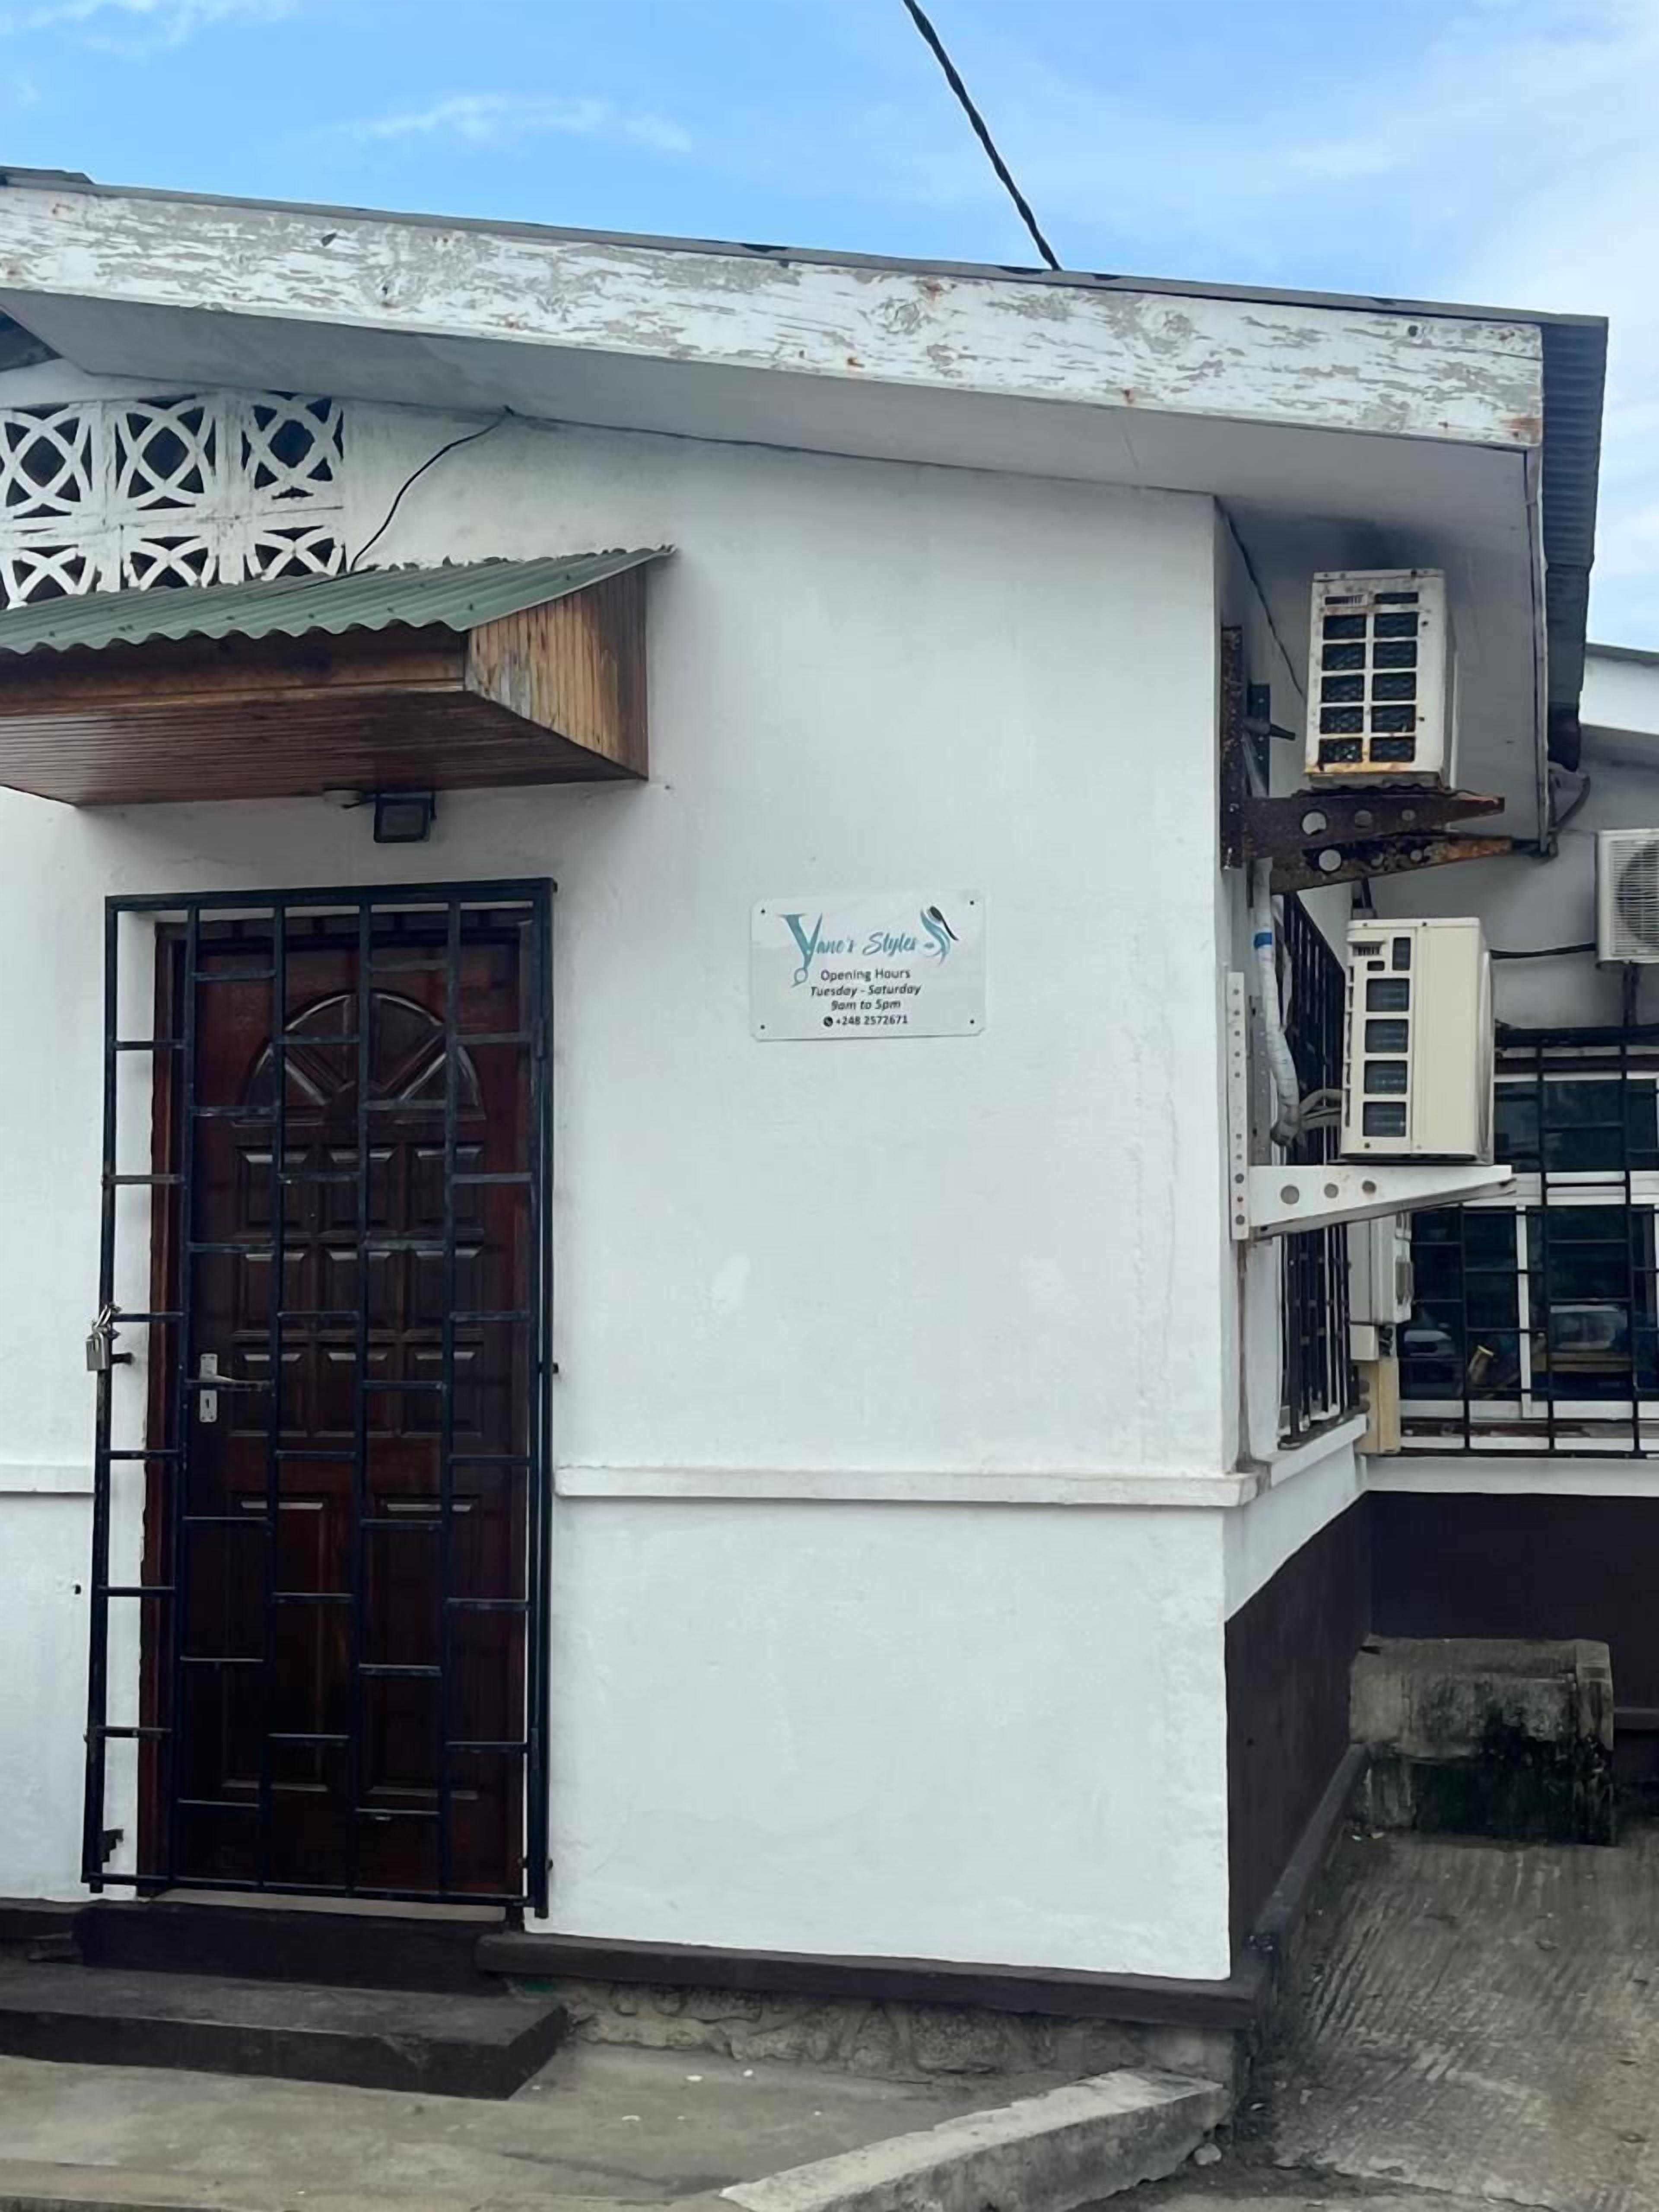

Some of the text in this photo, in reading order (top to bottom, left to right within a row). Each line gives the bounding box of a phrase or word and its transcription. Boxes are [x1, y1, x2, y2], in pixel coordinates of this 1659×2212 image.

[862, 931, 916, 957] Styles
[821, 969, 911, 982] Opening Hours
[811, 985, 858, 998] Tuesday
[868, 983, 922, 995] Saturday
[831, 999, 901, 1011] 9am to 5pm
[836, 1016, 861, 1025] +248
